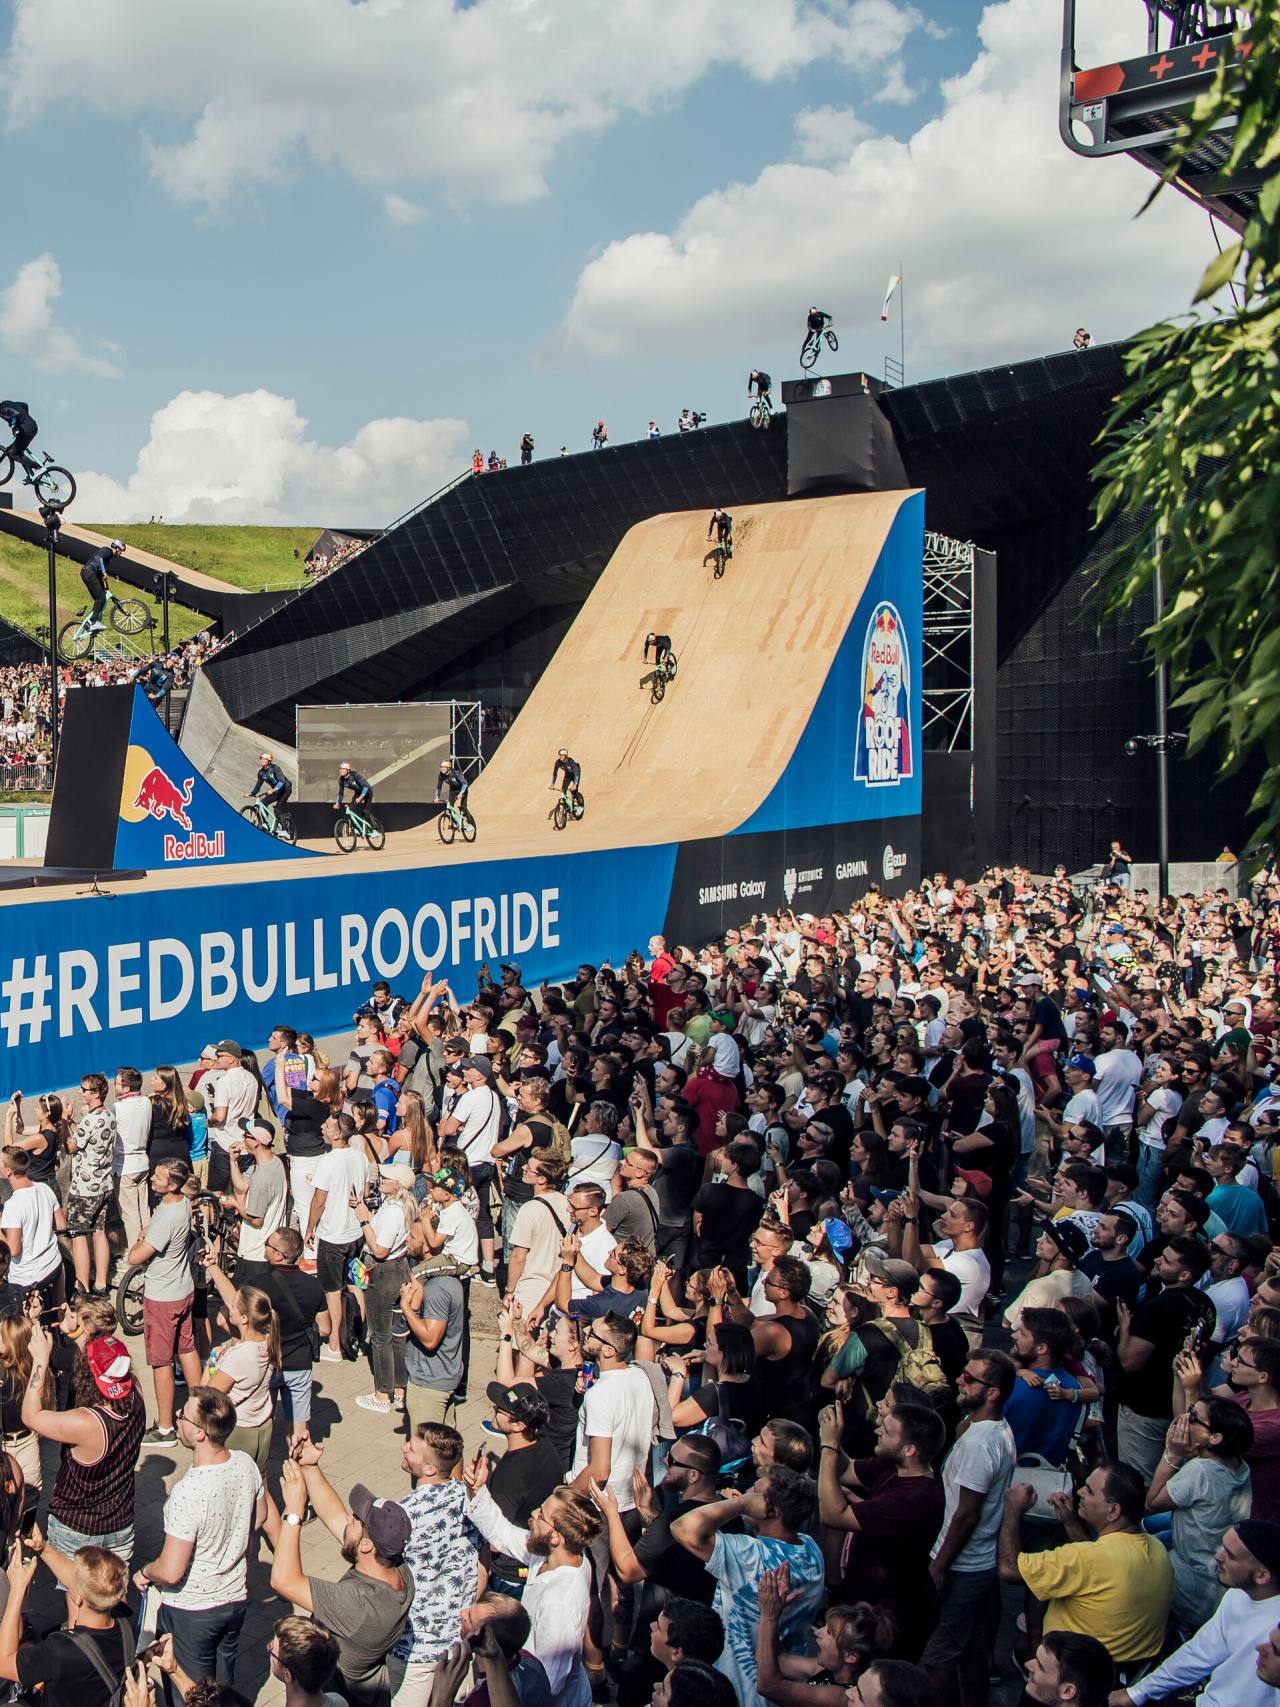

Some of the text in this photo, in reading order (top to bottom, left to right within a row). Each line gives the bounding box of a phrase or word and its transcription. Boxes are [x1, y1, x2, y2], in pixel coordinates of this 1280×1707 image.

[871, 642, 900, 666] Red Bull
[865, 716, 902, 749] ROOF
[868, 748, 899, 781] RIDE
[165, 831, 224, 860] Red Bull
[836, 860, 867, 880] GARMIN
[698, 880, 766, 905] SAMSUNG Galaxy
[0, 887, 561, 1049] #REDBULLROOFRIDE
[108, 1382, 123, 1398] USA
